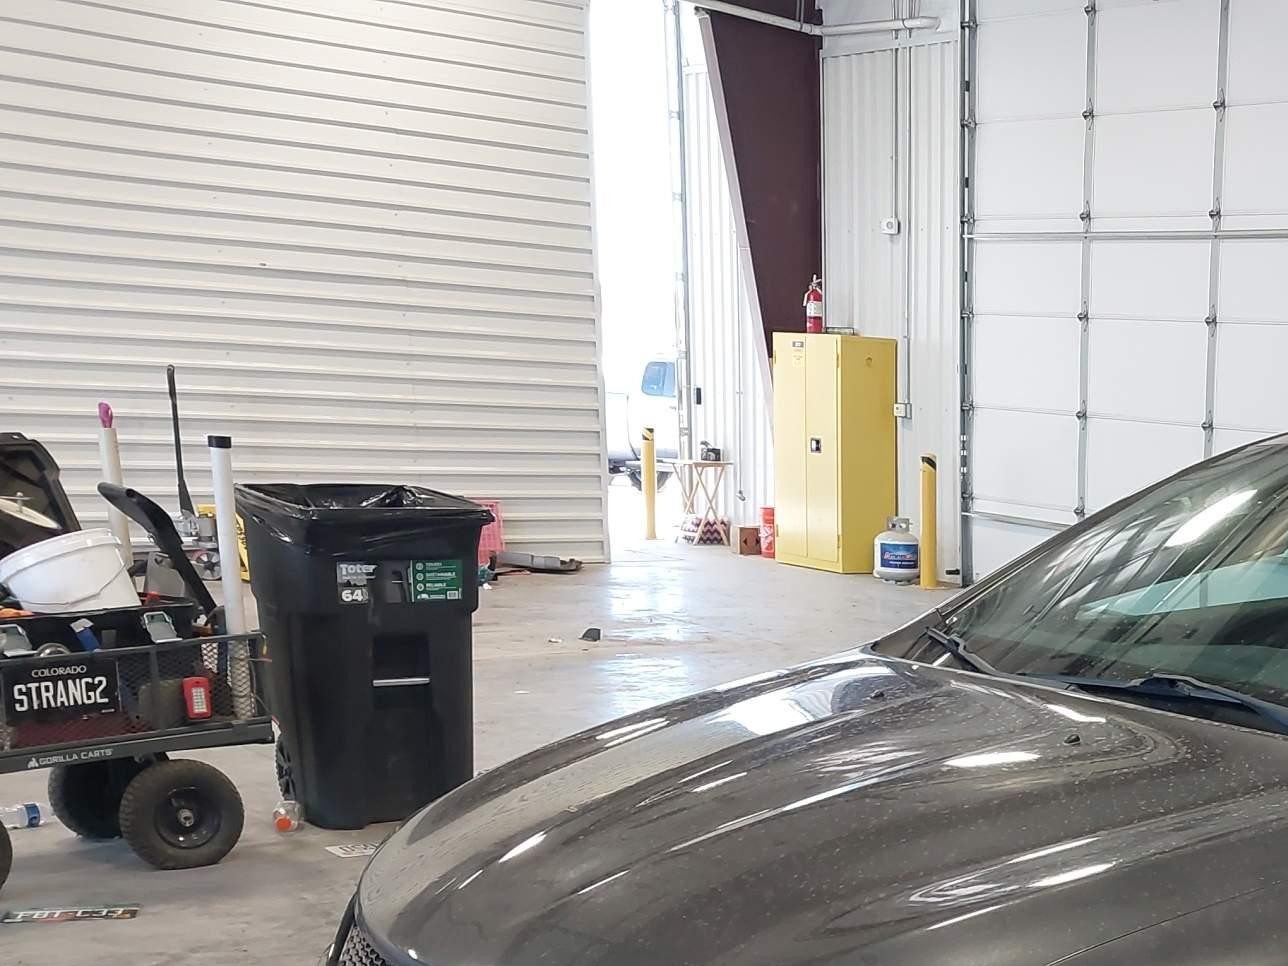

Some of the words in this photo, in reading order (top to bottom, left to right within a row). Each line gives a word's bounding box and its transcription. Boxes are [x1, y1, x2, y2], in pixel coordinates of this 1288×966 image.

[339, 564, 378, 575] Toter
[341, 589, 364, 602] 64
[31, 665, 87, 678] COLORADO
[13, 676, 109, 712] STRANG2
[39, 753, 79, 765] GORILLA
[80, 748, 113, 760] CARTS
